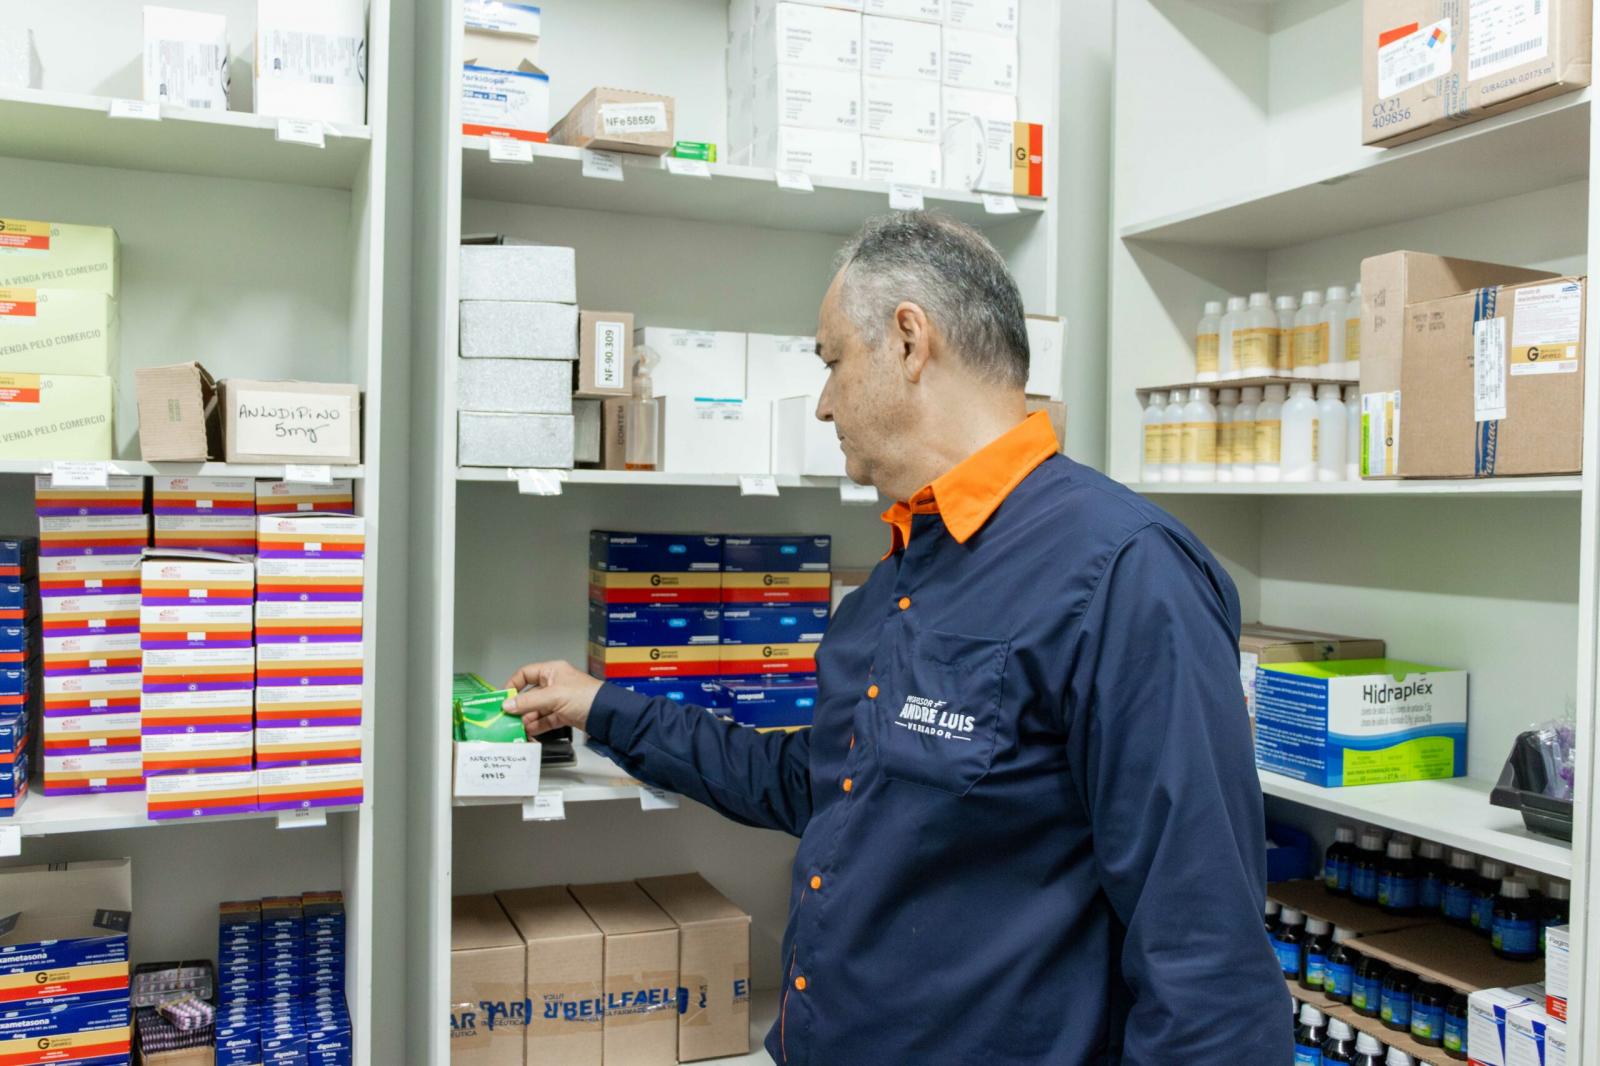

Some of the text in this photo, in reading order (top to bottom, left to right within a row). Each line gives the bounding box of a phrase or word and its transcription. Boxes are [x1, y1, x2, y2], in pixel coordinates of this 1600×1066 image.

[1372, 98, 1400, 116] CX 21
[1372, 108, 1411, 128] 409856
[12, 272, 40, 285] VENDA
[42, 270, 64, 280] PELO
[64, 262, 108, 276] COMERCIO
[30, 338, 53, 350] PELO
[54, 329, 101, 345] COMERCIO
[604, 330, 614, 382] NF-90.309
[2, 414, 106, 442] VENDA PELO COMERCIO
[275, 422, 330, 444] 5mg
[938, 711, 976, 732] LUIS
[35, 972, 48, 984] G
[37, 1038, 50, 1050] G
